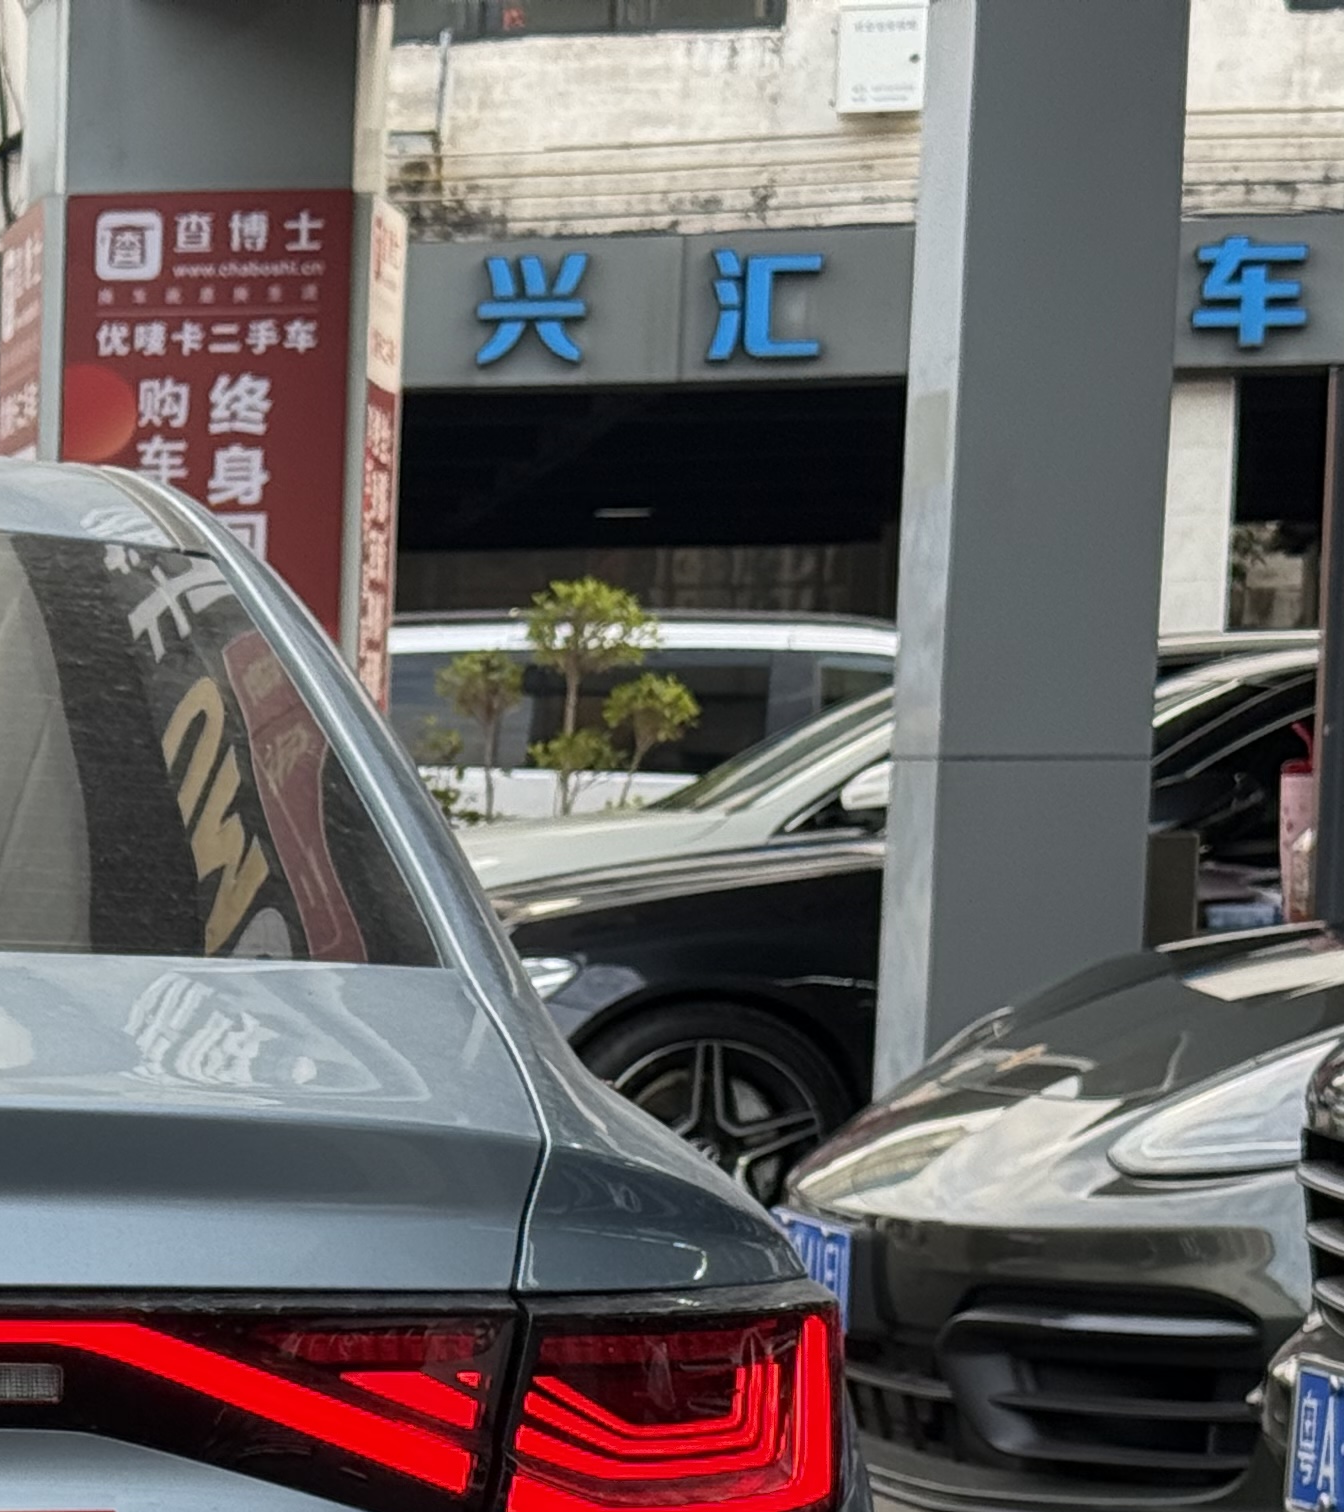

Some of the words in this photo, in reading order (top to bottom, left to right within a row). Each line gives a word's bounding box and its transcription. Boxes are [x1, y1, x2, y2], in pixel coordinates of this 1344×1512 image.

[173, 210, 325, 253] 查博士
[475, 247, 827, 367] 兴汇
[1191, 234, 1312, 351] 车
[137, 376, 190, 485] 购车
